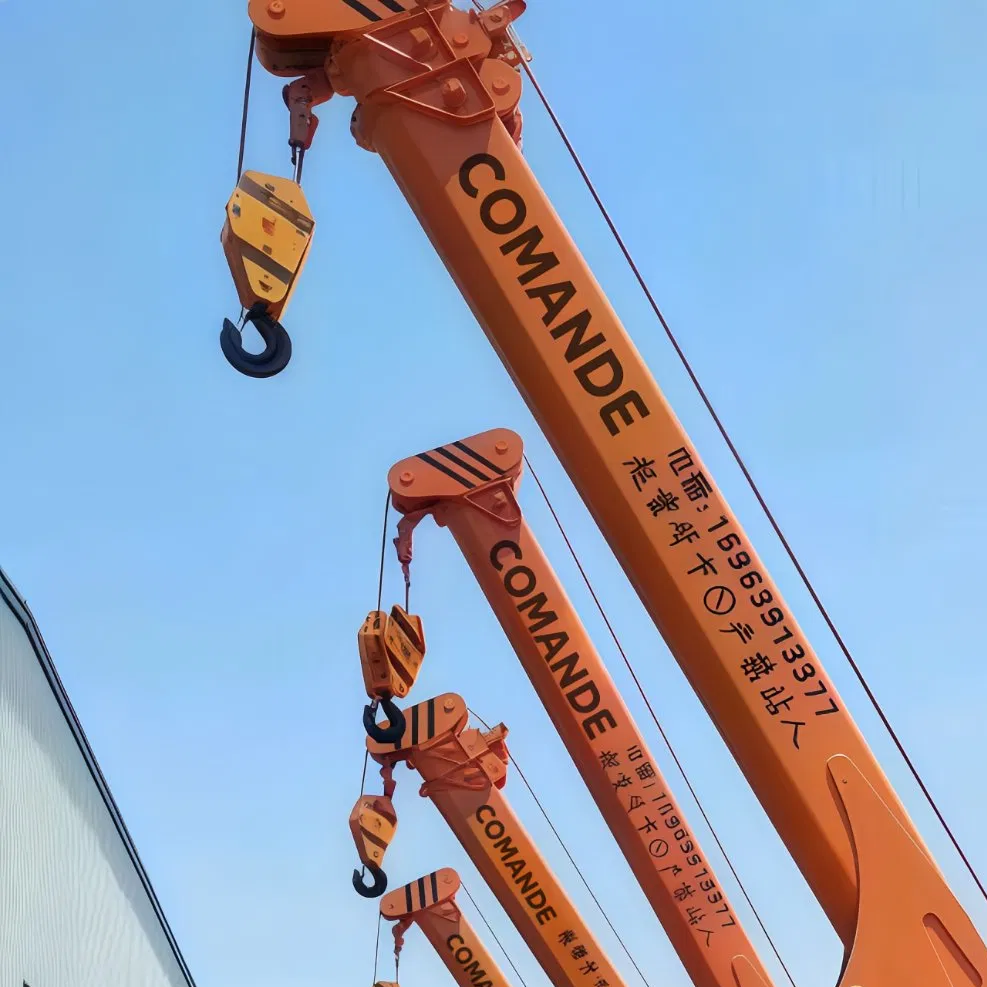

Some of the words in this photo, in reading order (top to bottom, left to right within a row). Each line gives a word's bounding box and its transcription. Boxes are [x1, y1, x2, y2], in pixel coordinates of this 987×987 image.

[458, 152, 650, 437] COMANDE
[489, 540, 617, 741] COMANDE
[475, 804, 558, 926] COMANDE
